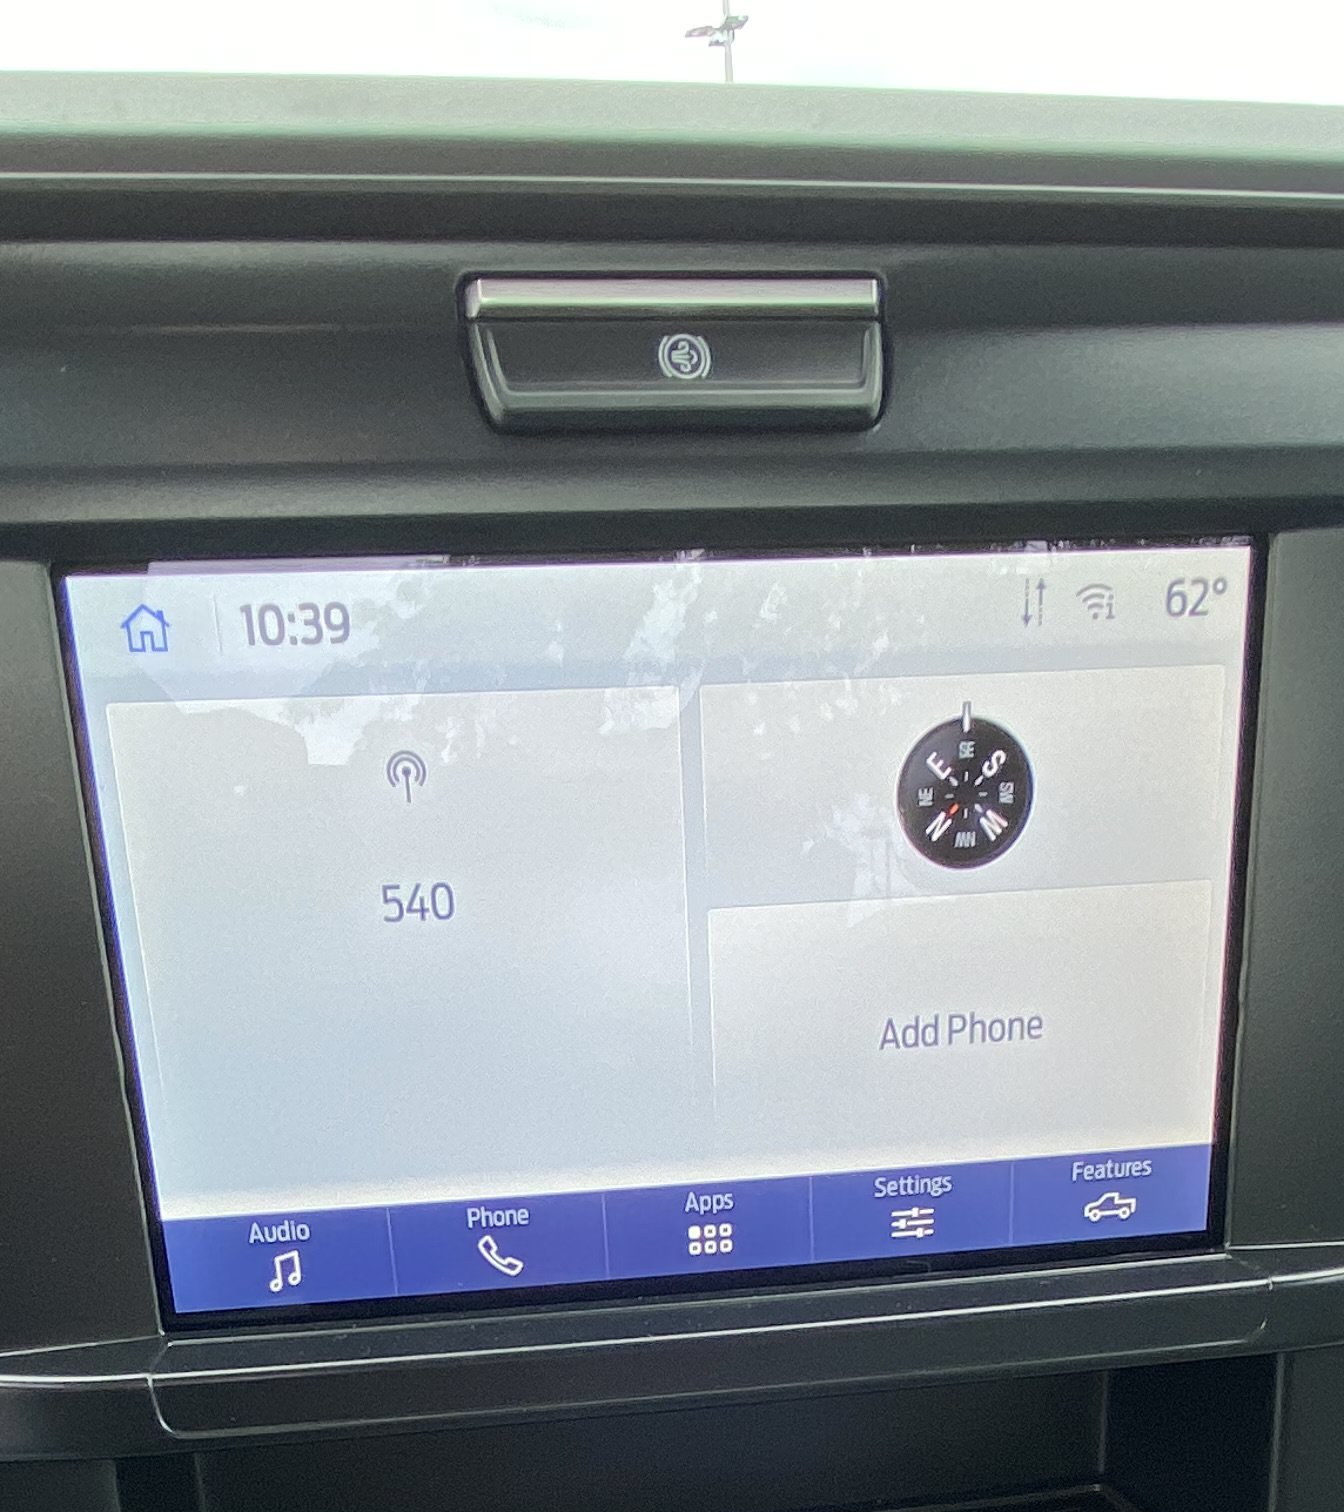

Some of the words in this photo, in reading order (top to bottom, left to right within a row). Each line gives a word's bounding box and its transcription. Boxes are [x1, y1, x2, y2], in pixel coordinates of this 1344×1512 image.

[1164, 576, 1229, 620] 62°
[240, 600, 352, 648] 10:39
[926, 752, 952, 780] E
[982, 750, 1006, 778] S
[925, 811, 953, 842] N
[980, 809, 1008, 841] W
[381, 881, 455, 924] 540
[879, 1012, 940, 1049] Add
[947, 1009, 1044, 1047] Phone
[1071, 1155, 1152, 1183] Features
[684, 1188, 734, 1218] Apps
[874, 1173, 954, 1203] Settings
[248, 1219, 310, 1246] Audio
[466, 1205, 529, 1233] Phone
